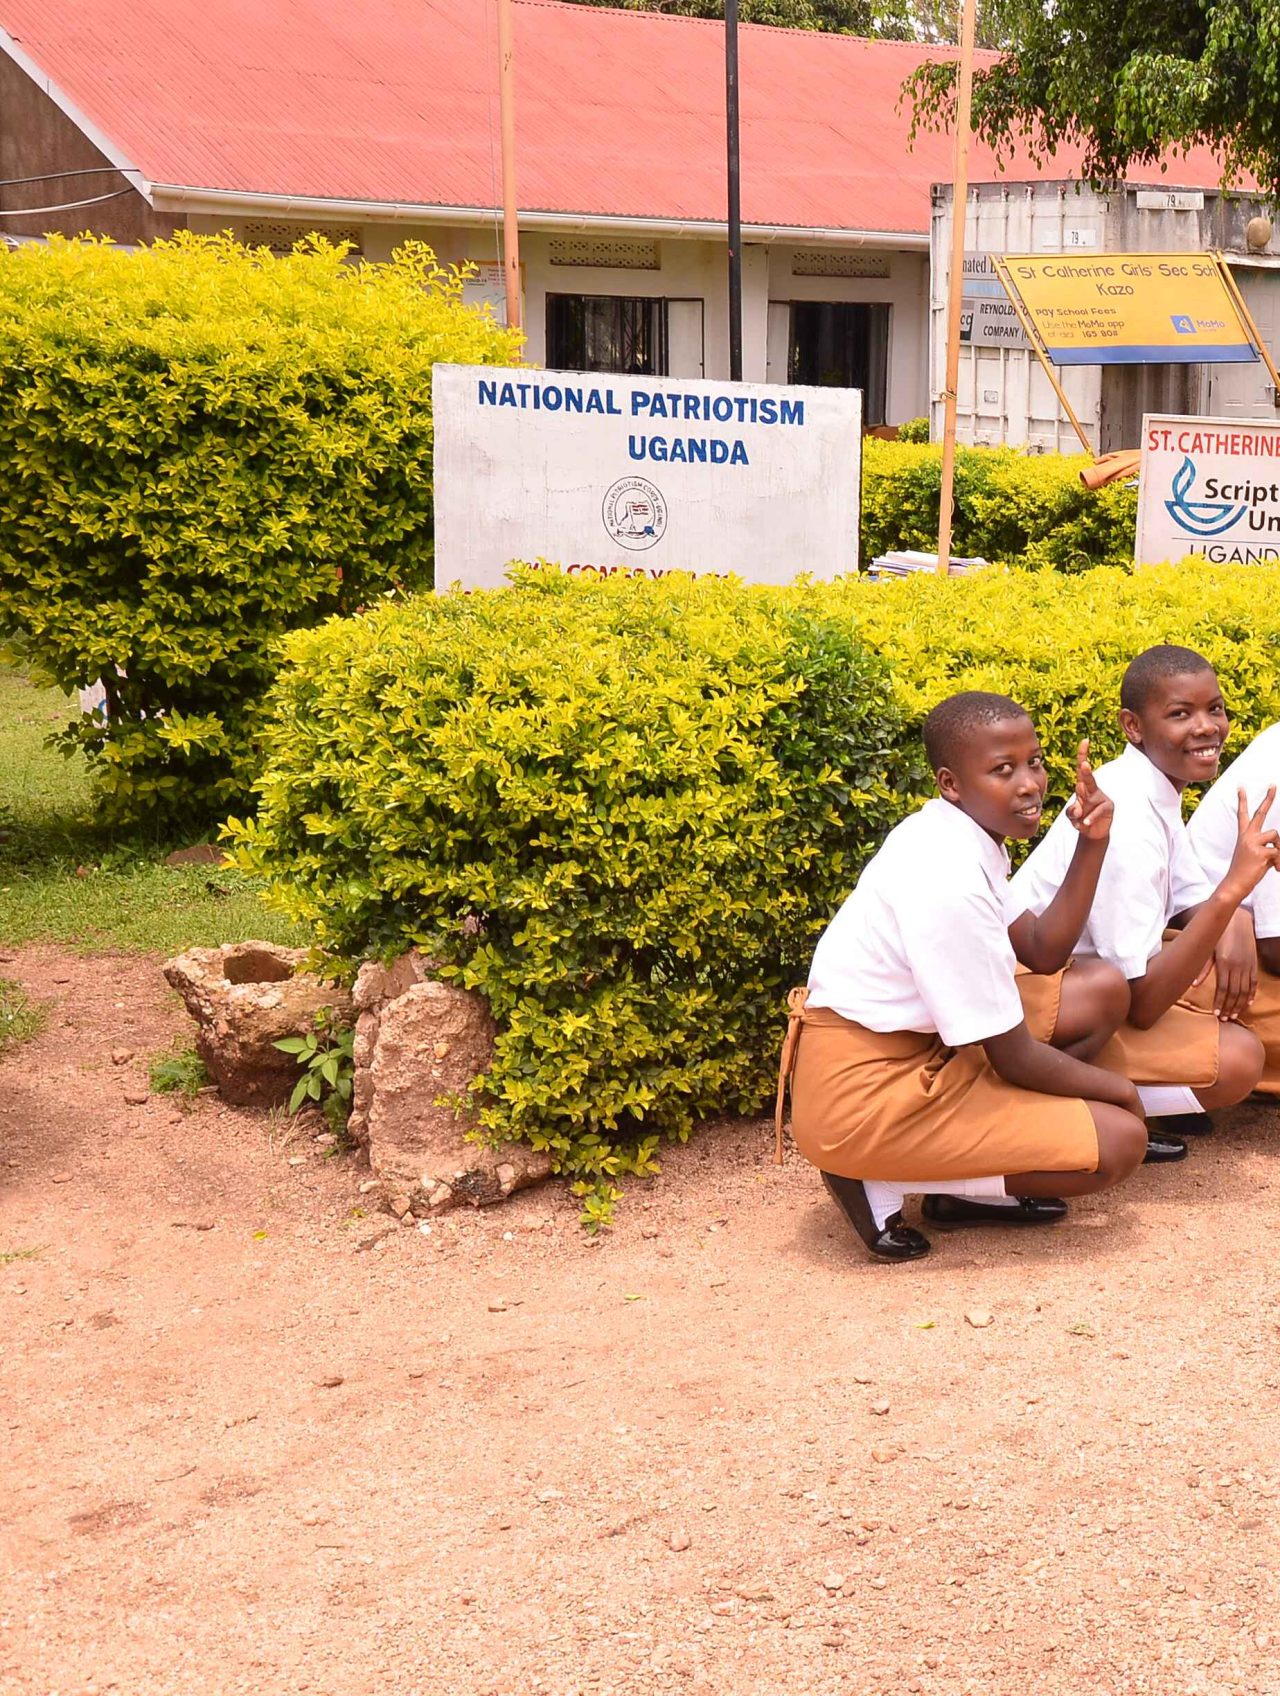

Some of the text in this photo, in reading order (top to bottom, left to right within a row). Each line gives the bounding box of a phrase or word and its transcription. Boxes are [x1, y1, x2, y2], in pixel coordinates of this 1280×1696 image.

[1158, 263, 1189, 277] Sec
[1095, 283, 1135, 296] Kazo
[980, 303, 1017, 316] REYNOLDS
[1056, 308, 1089, 316] School
[1090, 307, 1117, 315] Fees
[1077, 319, 1105, 329] MoMo
[1107, 320, 1125, 330] app
[1196, 319, 1226, 328] MoMo
[983, 325, 1019, 338] COMPANY
[478, 380, 805, 426] NATIONAL PATRIOTISM
[628, 435, 750, 466] UGANDA
